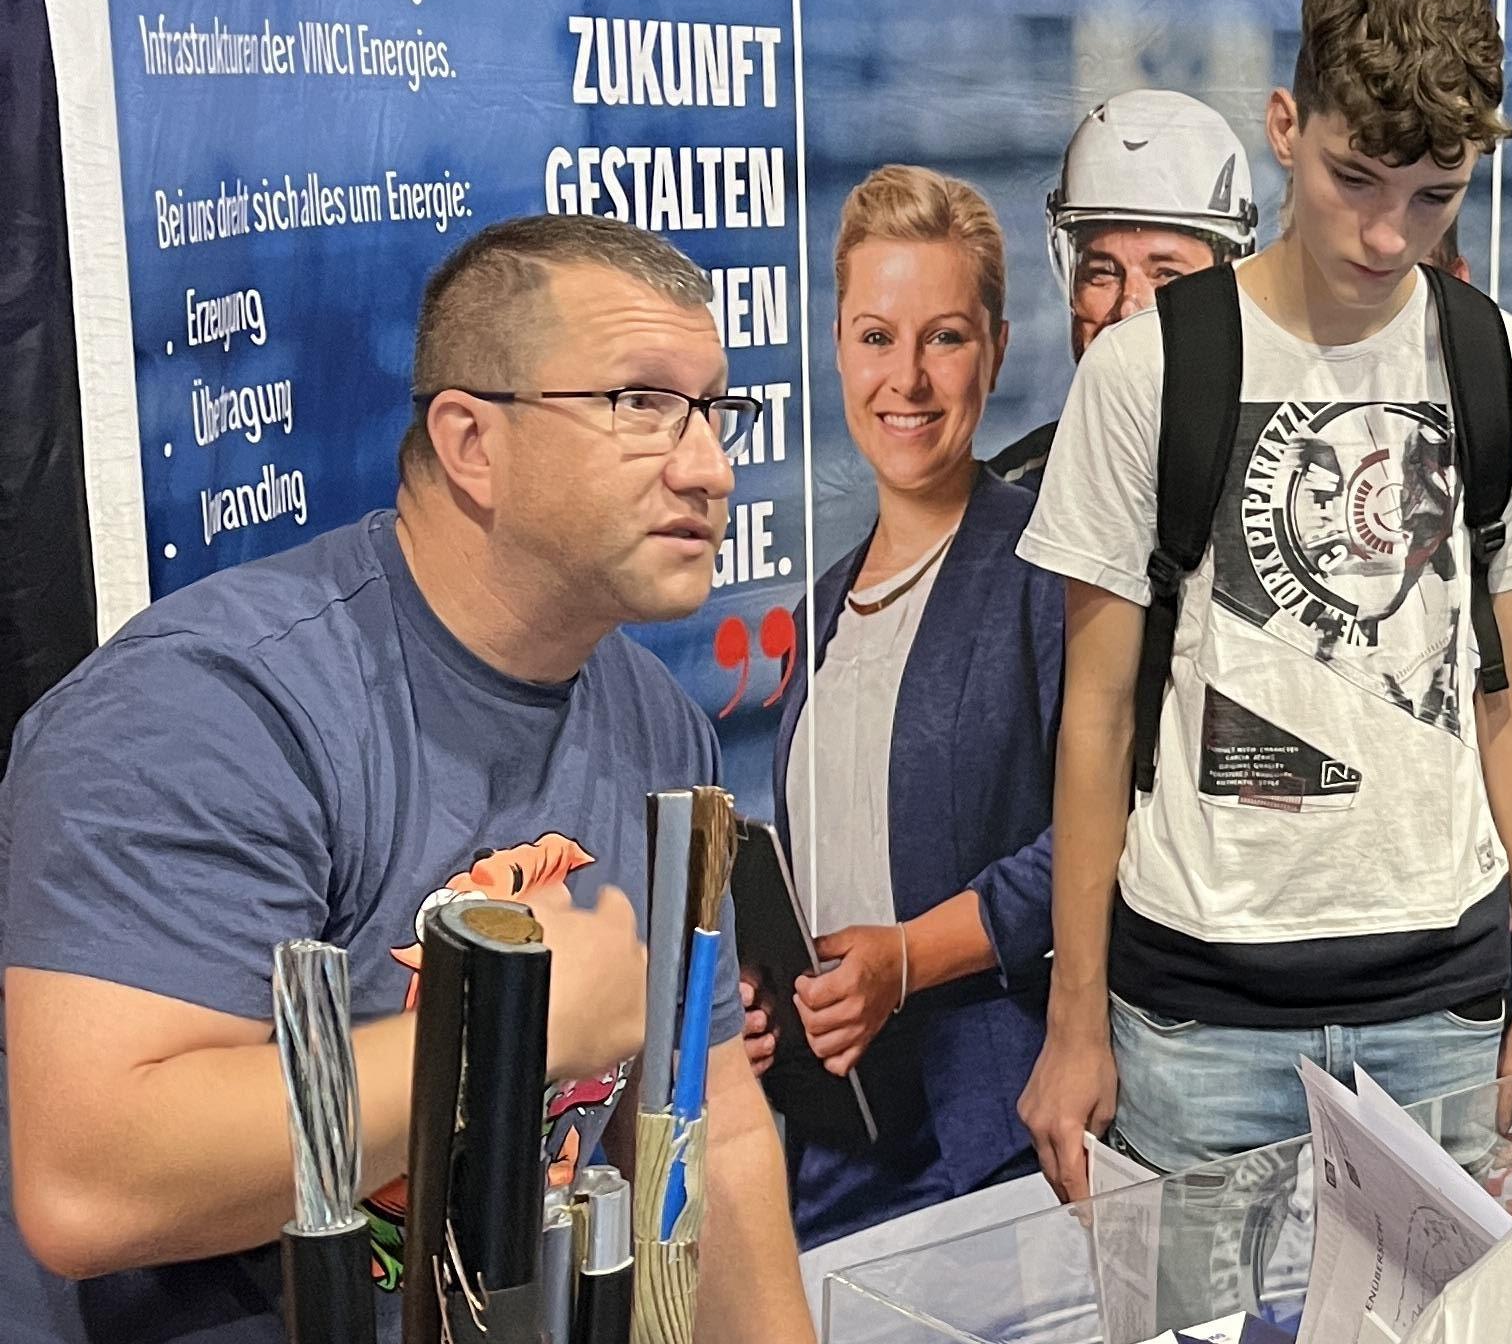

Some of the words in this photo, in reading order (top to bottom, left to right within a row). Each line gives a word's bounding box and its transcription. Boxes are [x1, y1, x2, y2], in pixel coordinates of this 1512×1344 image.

[139, 13, 258, 75] Infrastrukturen
[260, 18, 295, 75] der
[298, 20, 355, 76] VINCI
[357, 24, 457, 92] Energies.
[568, 16, 782, 108] ZUKUNFT
[155, 188, 185, 249] Bei
[187, 198, 215, 243] uns
[216, 178, 250, 239] dreht
[252, 174, 299, 233] sich
[300, 172, 347, 228] alles
[349, 184, 382, 224] um
[385, 170, 473, 233] Energie:
[545, 146, 785, 231] GESTALTEN
